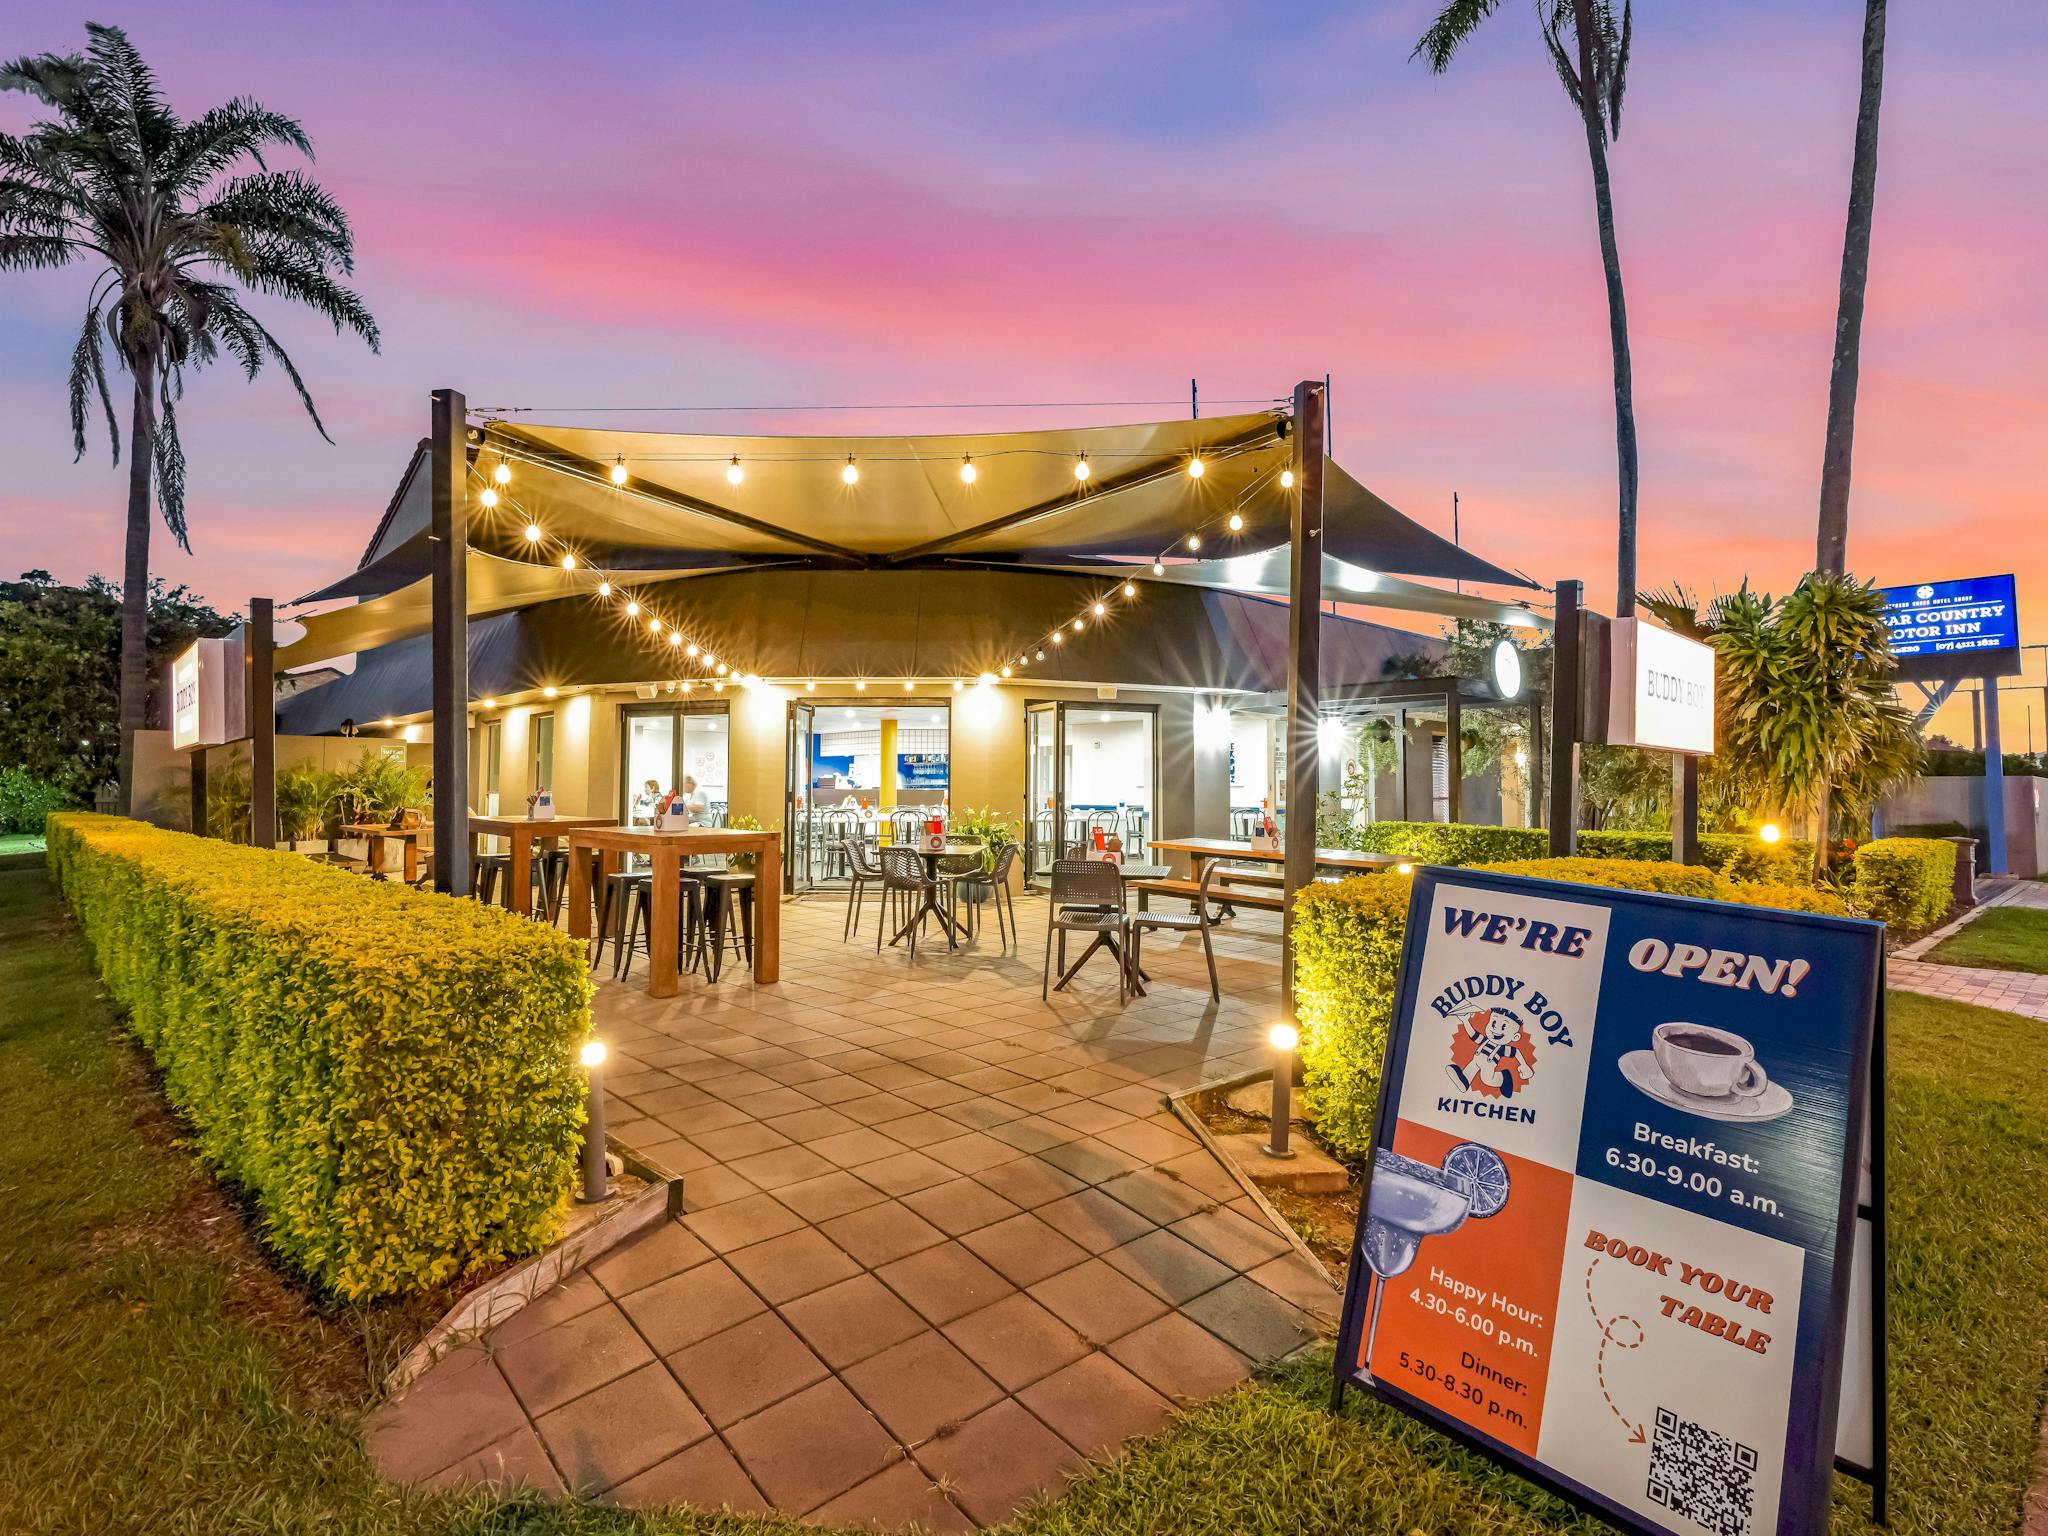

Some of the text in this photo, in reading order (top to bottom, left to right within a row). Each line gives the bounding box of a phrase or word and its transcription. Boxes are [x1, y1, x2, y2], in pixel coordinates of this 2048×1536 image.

[1887, 622, 1981, 640] OTOR INN
[1916, 605, 2005, 624] COUNTRY
[1648, 669, 1706, 710] BUDDY BOY
[1443, 906, 1593, 960] WE'RE
[1628, 938, 1811, 998] OPEN!
[1430, 974, 1574, 1048] BUDDY BOY
[1437, 1096, 1537, 1125] KITCHEN
[1633, 1122, 1760, 1174] Breakfast:
[1605, 1147, 1785, 1218] 6.30-9.00 a.m.
[1429, 1266, 1544, 1329] Happy Hour:
[1584, 1229, 1774, 1315] BOOK YOUR
[1409, 1287, 1538, 1358] 4.30-6.00 p.m.
[1660, 1294, 1771, 1355] TABLE
[1399, 1351, 1528, 1430] 5.30-8.30 p.m.
[1461, 1351, 1528, 1397] Dinner:
